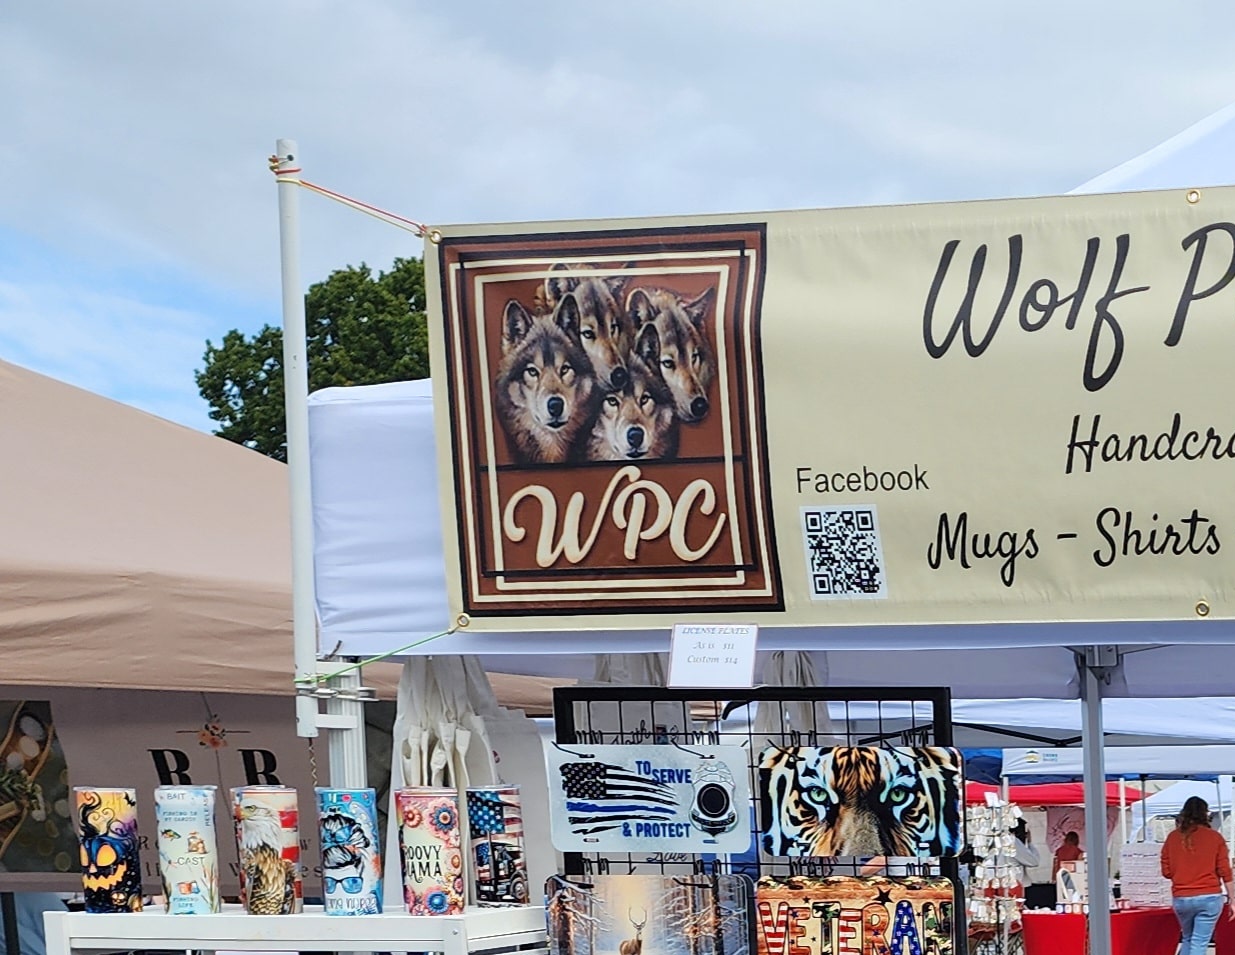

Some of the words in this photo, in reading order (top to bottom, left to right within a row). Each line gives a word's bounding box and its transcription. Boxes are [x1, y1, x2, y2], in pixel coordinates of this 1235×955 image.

[922, 233, 1150, 393] Wolf
[796, 463, 931, 494] Facebook
[504, 465, 726, 568] WPC
[927, 510, 1039, 588] Mugs
[1092, 507, 1221, 568] Shirts
[682, 627, 717, 635] LICENSE
[717, 627, 750, 635] PLATES
[687, 655, 720, 664] Custom
[635, 760, 652, 776] TO
[652, 768, 693, 784] SERVE
[635, 823, 691, 838] PROTECT
[177, 857, 205, 866] CAST
